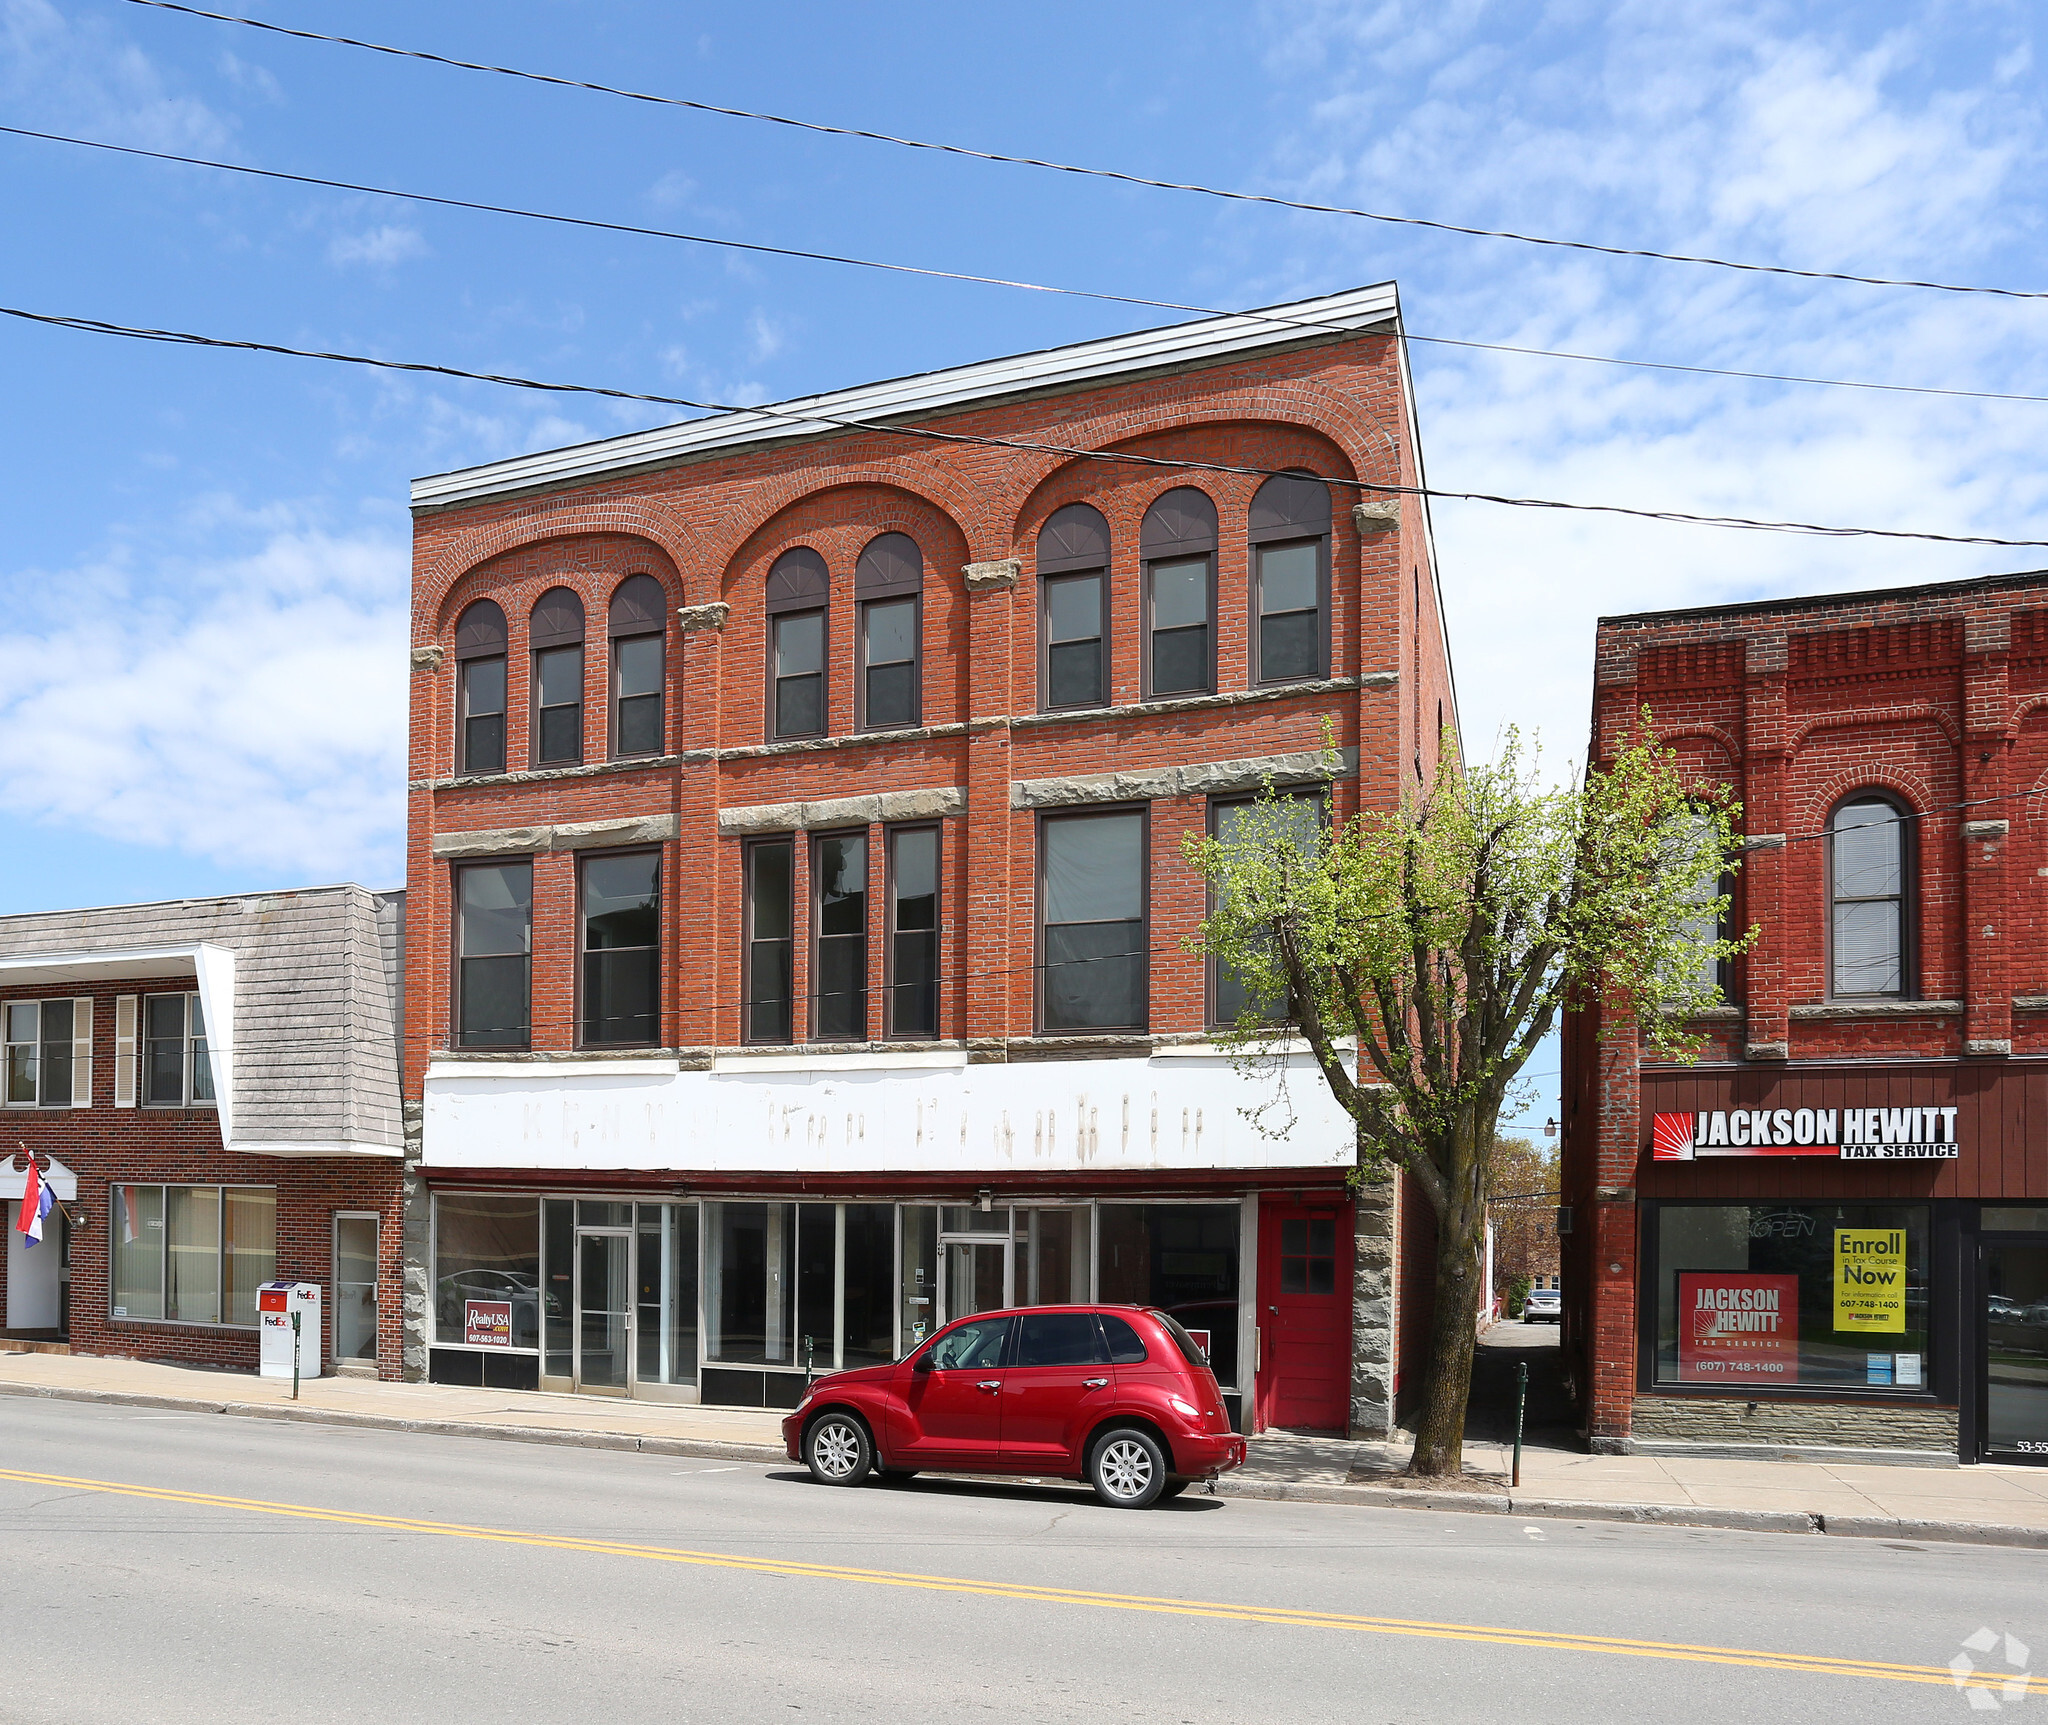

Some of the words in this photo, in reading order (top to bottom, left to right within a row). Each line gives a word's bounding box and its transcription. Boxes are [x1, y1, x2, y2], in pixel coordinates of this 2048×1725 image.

[1695, 1109, 1837, 1146] JACKSON
[1843, 1106, 1958, 1144] HEWITT
[1844, 1146, 1877, 1158] TAX
[1883, 1144, 1957, 1157] SERVICE
[1752, 1220, 1816, 1238] OPEN
[1841, 1233, 1899, 1254] Enroll
[1853, 1256, 1865, 1264] Tax
[1869, 1256, 1897, 1264] Course
[1844, 1265, 1896, 1285] Now
[297, 1290, 316, 1299] FedEx
[1695, 1288, 1779, 1311] JACKSON
[1853, 1291, 1886, 1299] information
[265, 1317, 286, 1326] FedEx
[467, 1310, 509, 1330] RealtyUSA
[1717, 1311, 1779, 1332] HEWITT
[1695, 1361, 1726, 1373] (607)
[1729, 1362, 1784, 1373] 748-1400
[2017, 1441, 2048, 1453] 53-55
